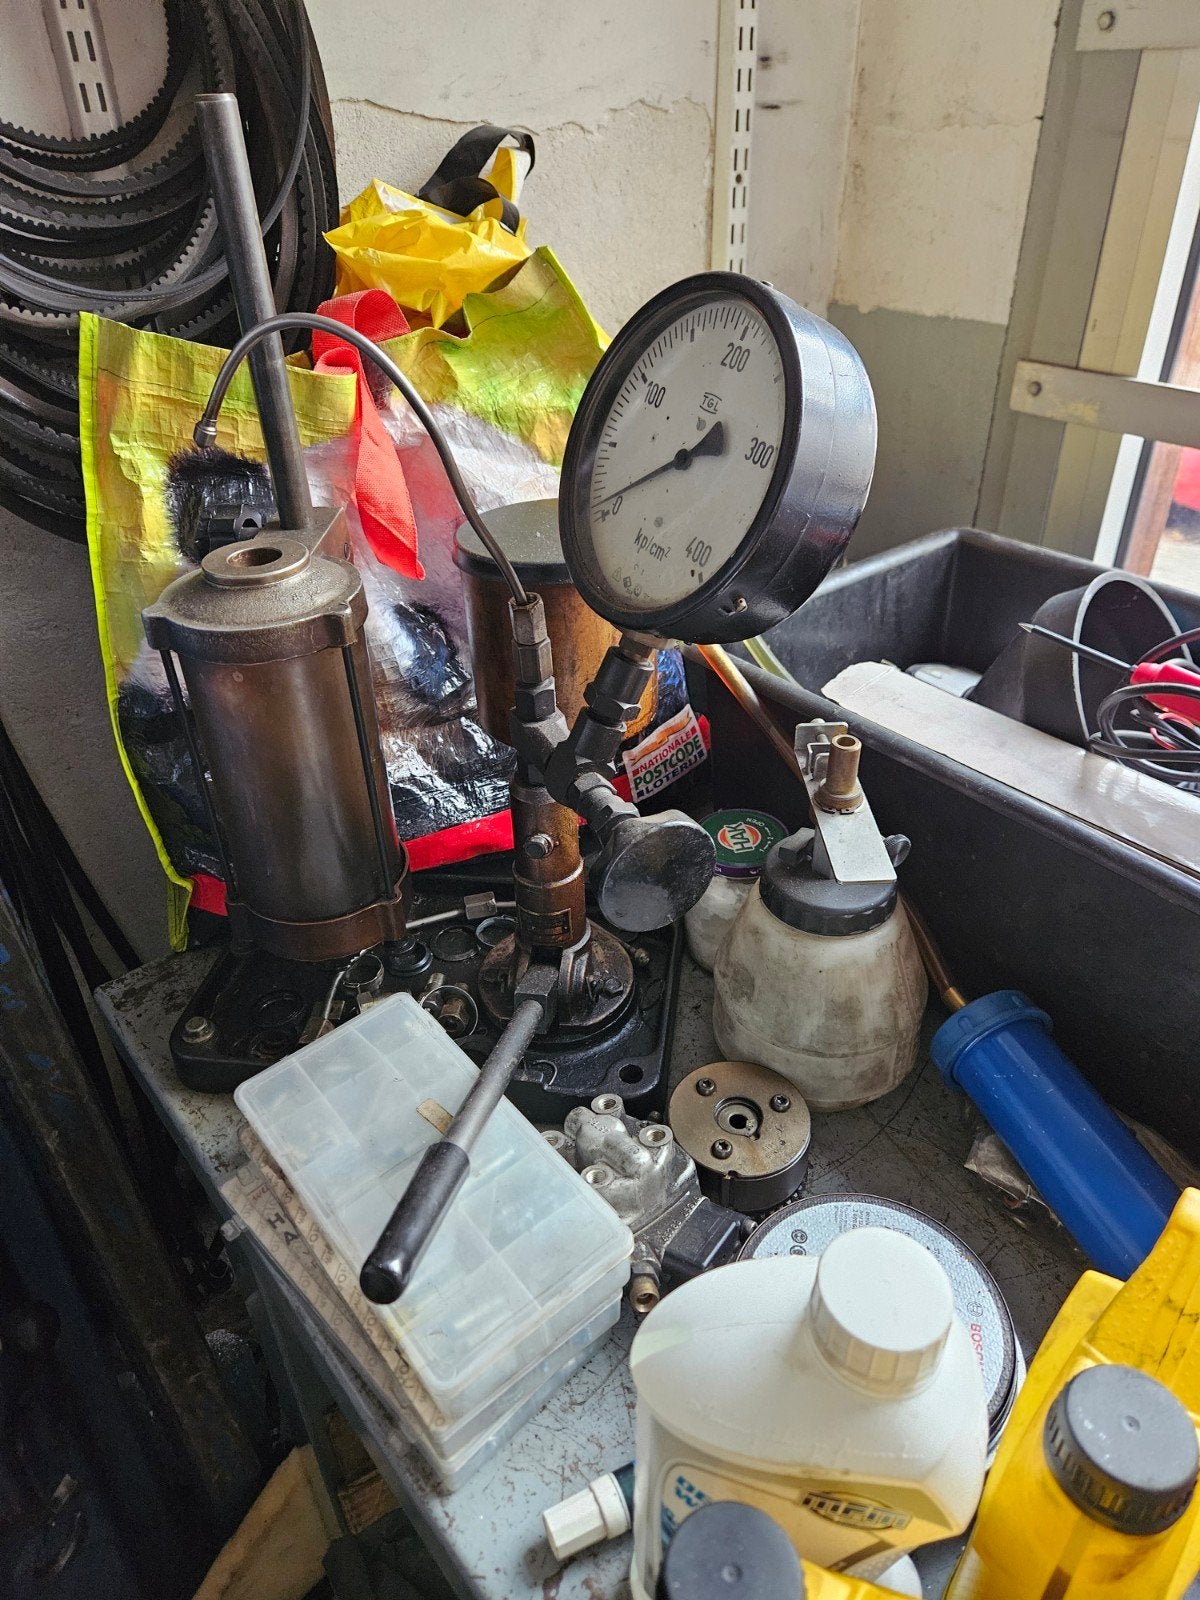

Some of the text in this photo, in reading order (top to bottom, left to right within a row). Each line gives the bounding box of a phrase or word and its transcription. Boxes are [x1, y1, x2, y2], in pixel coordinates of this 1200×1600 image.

[720, 342, 751, 373] 200
[645, 380, 666, 409] 100
[702, 394, 719, 413] TGL
[744, 437, 775, 469] 300
[611, 495, 623, 516] 0
[685, 536, 712, 568] 400
[633, 736, 702, 791] POSTCODE
[638, 732, 692, 773] NATIONALE
[645, 755, 700, 794] LOTERIJ
[726, 823, 754, 852] HAK
